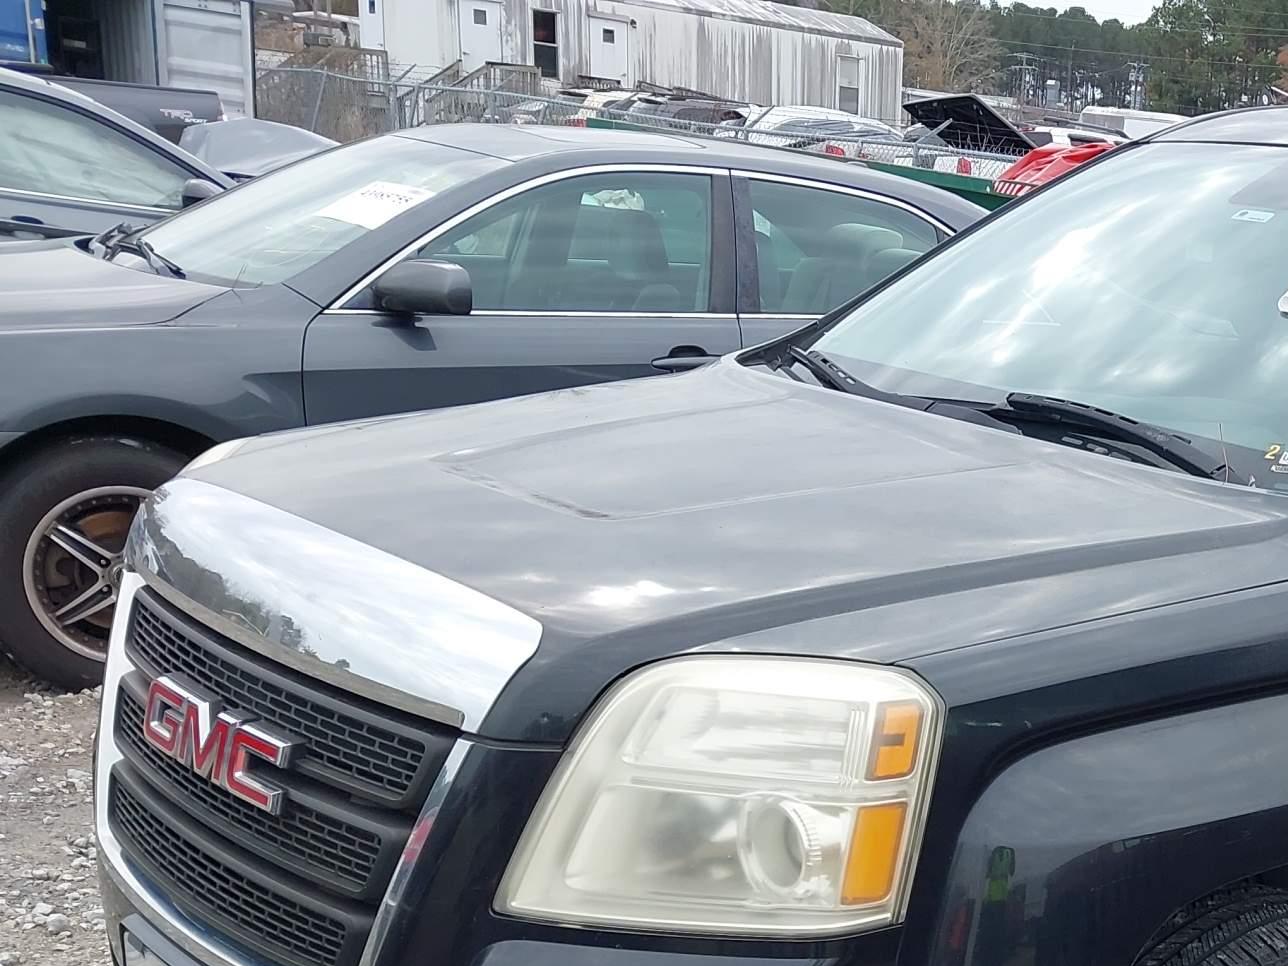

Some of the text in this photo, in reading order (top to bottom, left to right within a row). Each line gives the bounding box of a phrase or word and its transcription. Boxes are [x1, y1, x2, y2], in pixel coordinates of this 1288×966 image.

[159, 108, 193, 120] TRD
[1264, 443, 1281, 460] 2
[143, 676, 292, 816] GMC
